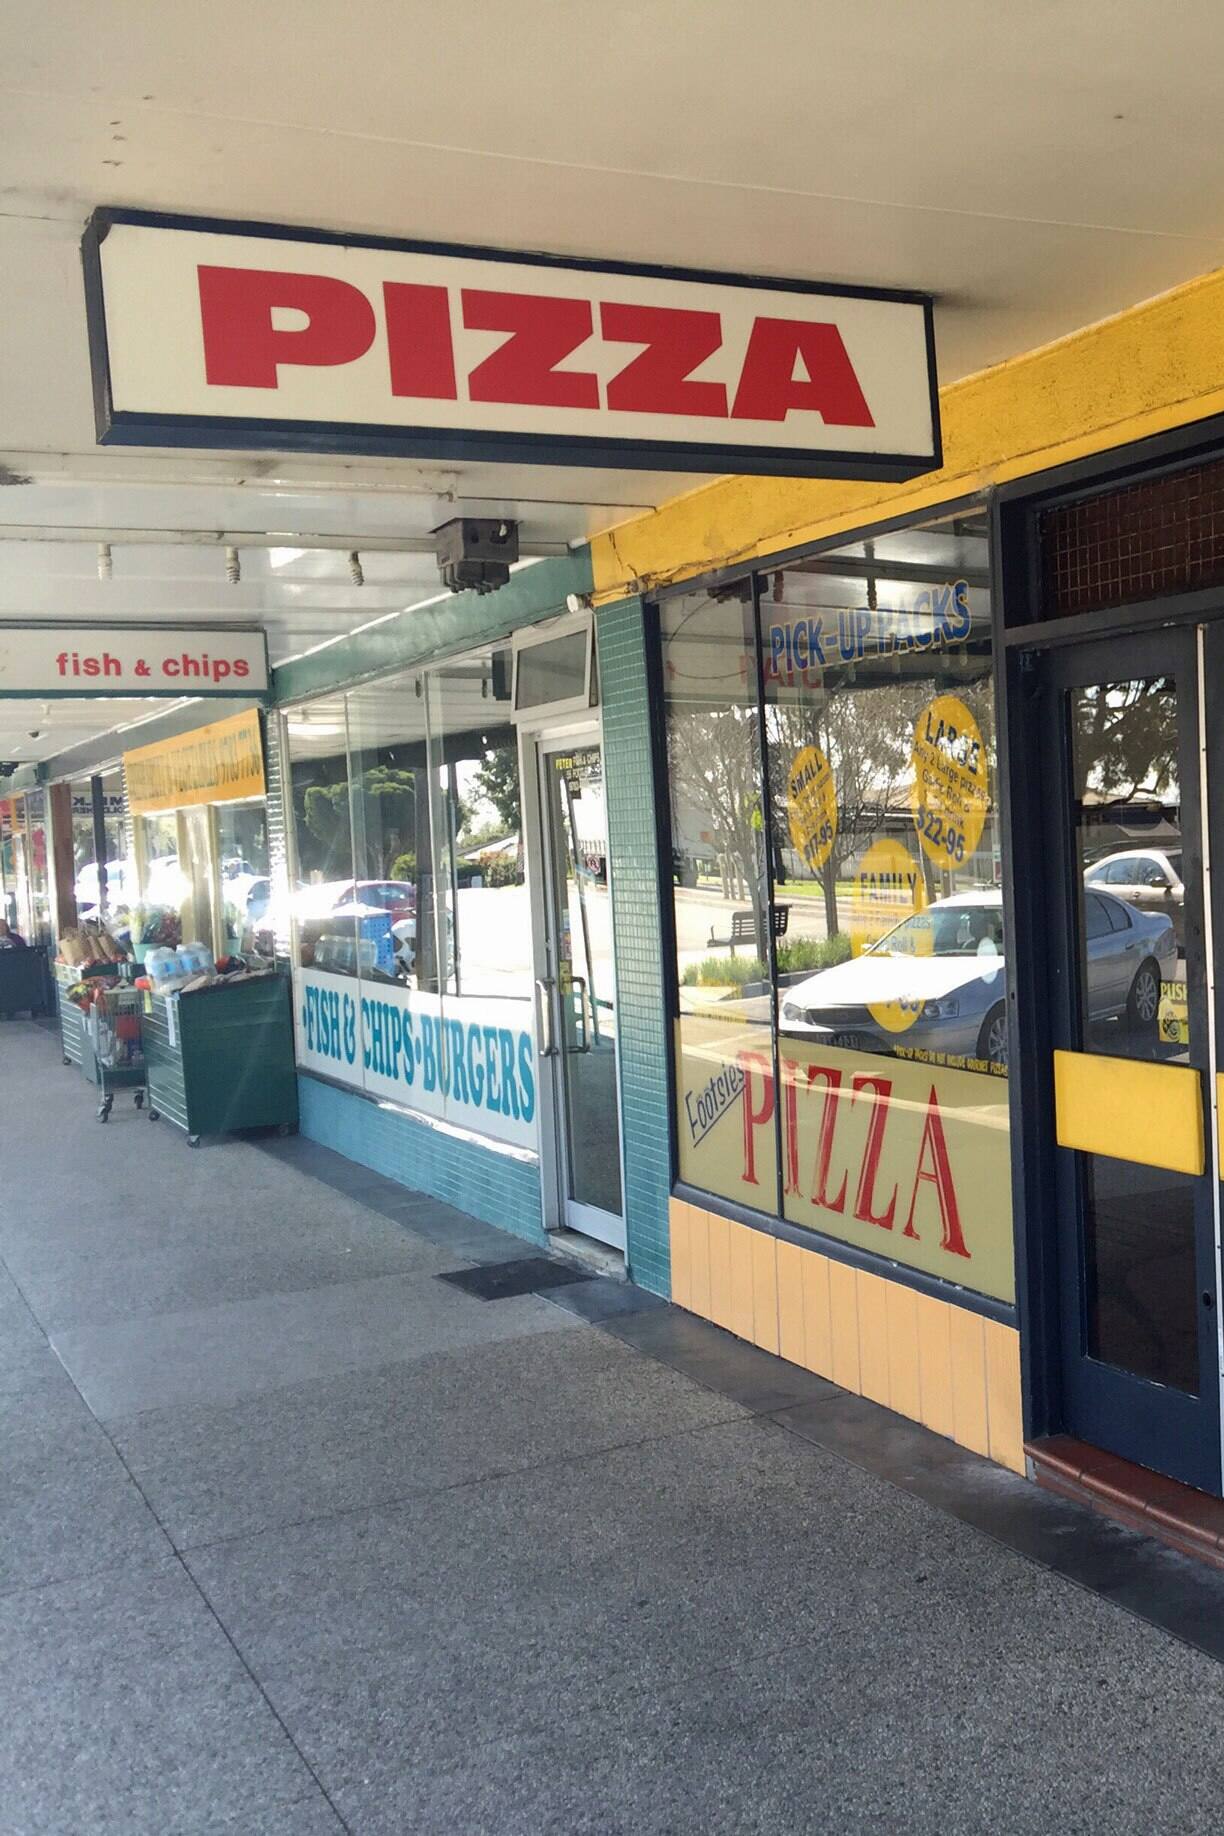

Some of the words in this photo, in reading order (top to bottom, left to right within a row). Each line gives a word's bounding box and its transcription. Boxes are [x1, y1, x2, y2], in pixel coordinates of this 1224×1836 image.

[197, 265, 875, 428] PIZZA
[56, 652, 122, 677] fish
[134, 659, 151, 677] &
[162, 654, 249, 683] chips
[769, 610, 871, 679] PICK-UP
[877, 579, 972, 656] PACKS
[790, 752, 823, 800] SMALL
[860, 872, 917, 905] FAMILY
[305, 984, 341, 1061] FISH
[344, 993, 356, 1065] &
[685, 1061, 746, 1140] Footsies
[735, 1050, 972, 1259] PIZZA
